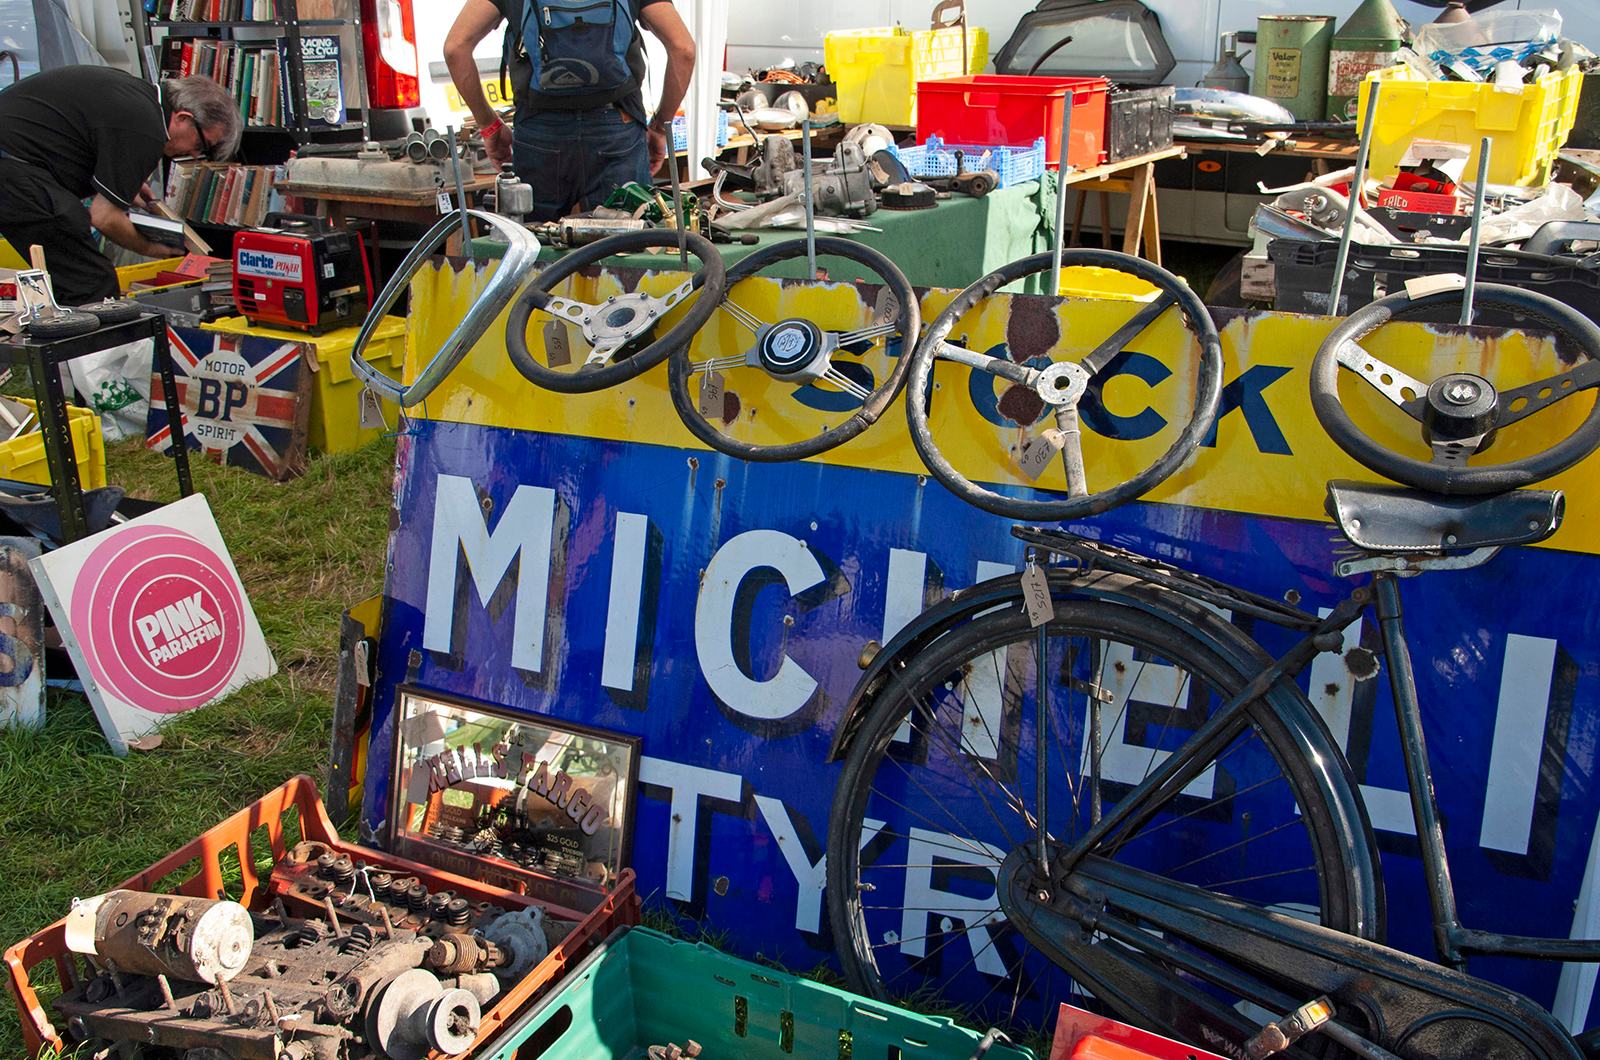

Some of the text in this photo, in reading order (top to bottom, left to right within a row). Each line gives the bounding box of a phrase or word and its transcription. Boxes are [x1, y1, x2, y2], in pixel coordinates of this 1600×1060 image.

[300, 38, 332, 48] RACING
[316, 46, 338, 56] CYCLE
[1272, 52, 1296, 60] Valor
[1383, 195, 1408, 208] TRICO
[240, 251, 299, 276] Clarke POWER
[204, 360, 246, 376] MOTOR
[198, 424, 236, 440] SPIRIT
[1035, 442, 1050, 464] £30
[1031, 582, 1048, 610] £125
[136, 590, 214, 651] PINK
[150, 620, 221, 667] PARAFFIN
[502, 728, 525, 747] THE
[427, 742, 605, 836] WELLS FARGO
[444, 806, 462, 816] GOLD
[546, 834, 579, 848] $25 GOLD
[562, 846, 584, 857] TUCSON
